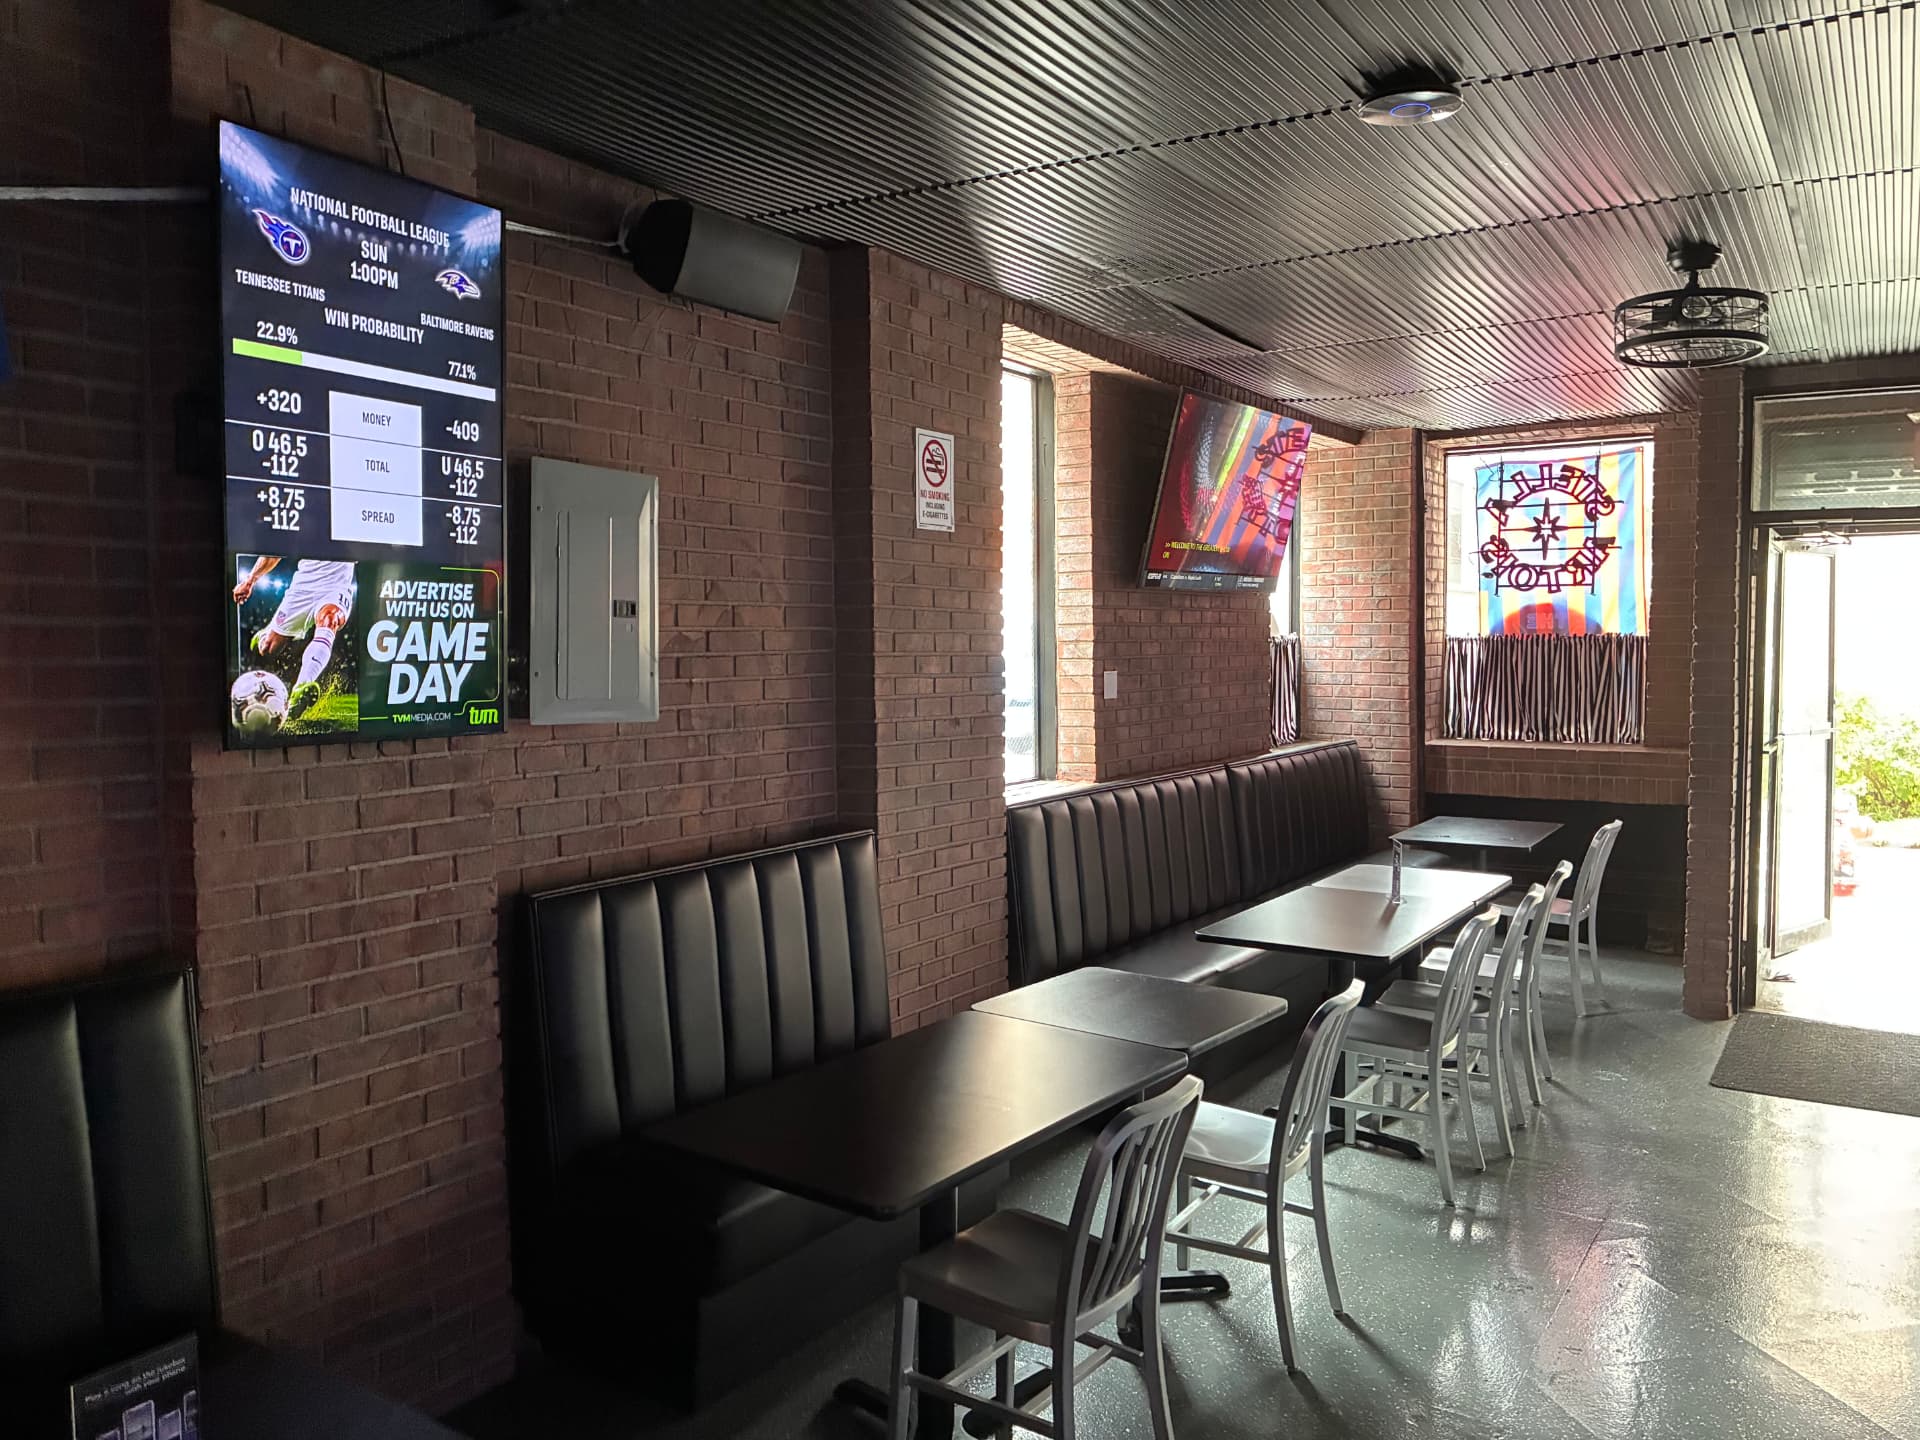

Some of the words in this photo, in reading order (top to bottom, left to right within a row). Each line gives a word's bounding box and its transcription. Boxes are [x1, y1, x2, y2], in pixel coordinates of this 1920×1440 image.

[290, 187, 350, 219] NATIONAL
[352, 205, 408, 236] FOOTBALL
[410, 222, 450, 248] LEAGUE
[360, 240, 388, 264] SUN
[235, 269, 291, 295] TENNESSEE
[292, 282, 326, 302] TITANS
[350, 263, 399, 290] 1:00PM
[256, 321, 298, 345] 22.9%
[324, 308, 349, 330] WIN
[352, 313, 424, 344] PROBABILITY
[420, 312, 464, 336] BALTIMORE
[465, 323, 494, 342] RAVENS
[448, 360, 476, 381] 77.1%
[256, 388, 302, 414] +320
[362, 411, 392, 428] MONEY
[446, 420, 480, 442] -409
[268, 430, 308, 457] 46.5
[262, 455, 300, 478] -112
[364, 459, 390, 474] TOTAL
[441, 456, 450, 476] U
[454, 457, 484, 480] 46.5
[257, 486, 305, 510] +8.75
[449, 478, 478, 498] -112
[920, 490, 928, 498] NO
[928, 490, 950, 502] SMOKING
[263, 509, 300, 531] -112
[362, 510, 395, 524] SPREAD
[446, 507, 480, 526] -8.75
[449, 526, 478, 545] -112
[380, 580, 474, 601] ADVERTISE
[386, 600, 428, 617] WITH
[430, 602, 450, 618] US
[452, 603, 475, 619] ON
[366, 619, 490, 663] GAME
[388, 663, 474, 704] DAY
[392, 712, 452, 724] TVMMEDIA.COM
[468, 706, 499, 724] tvm
